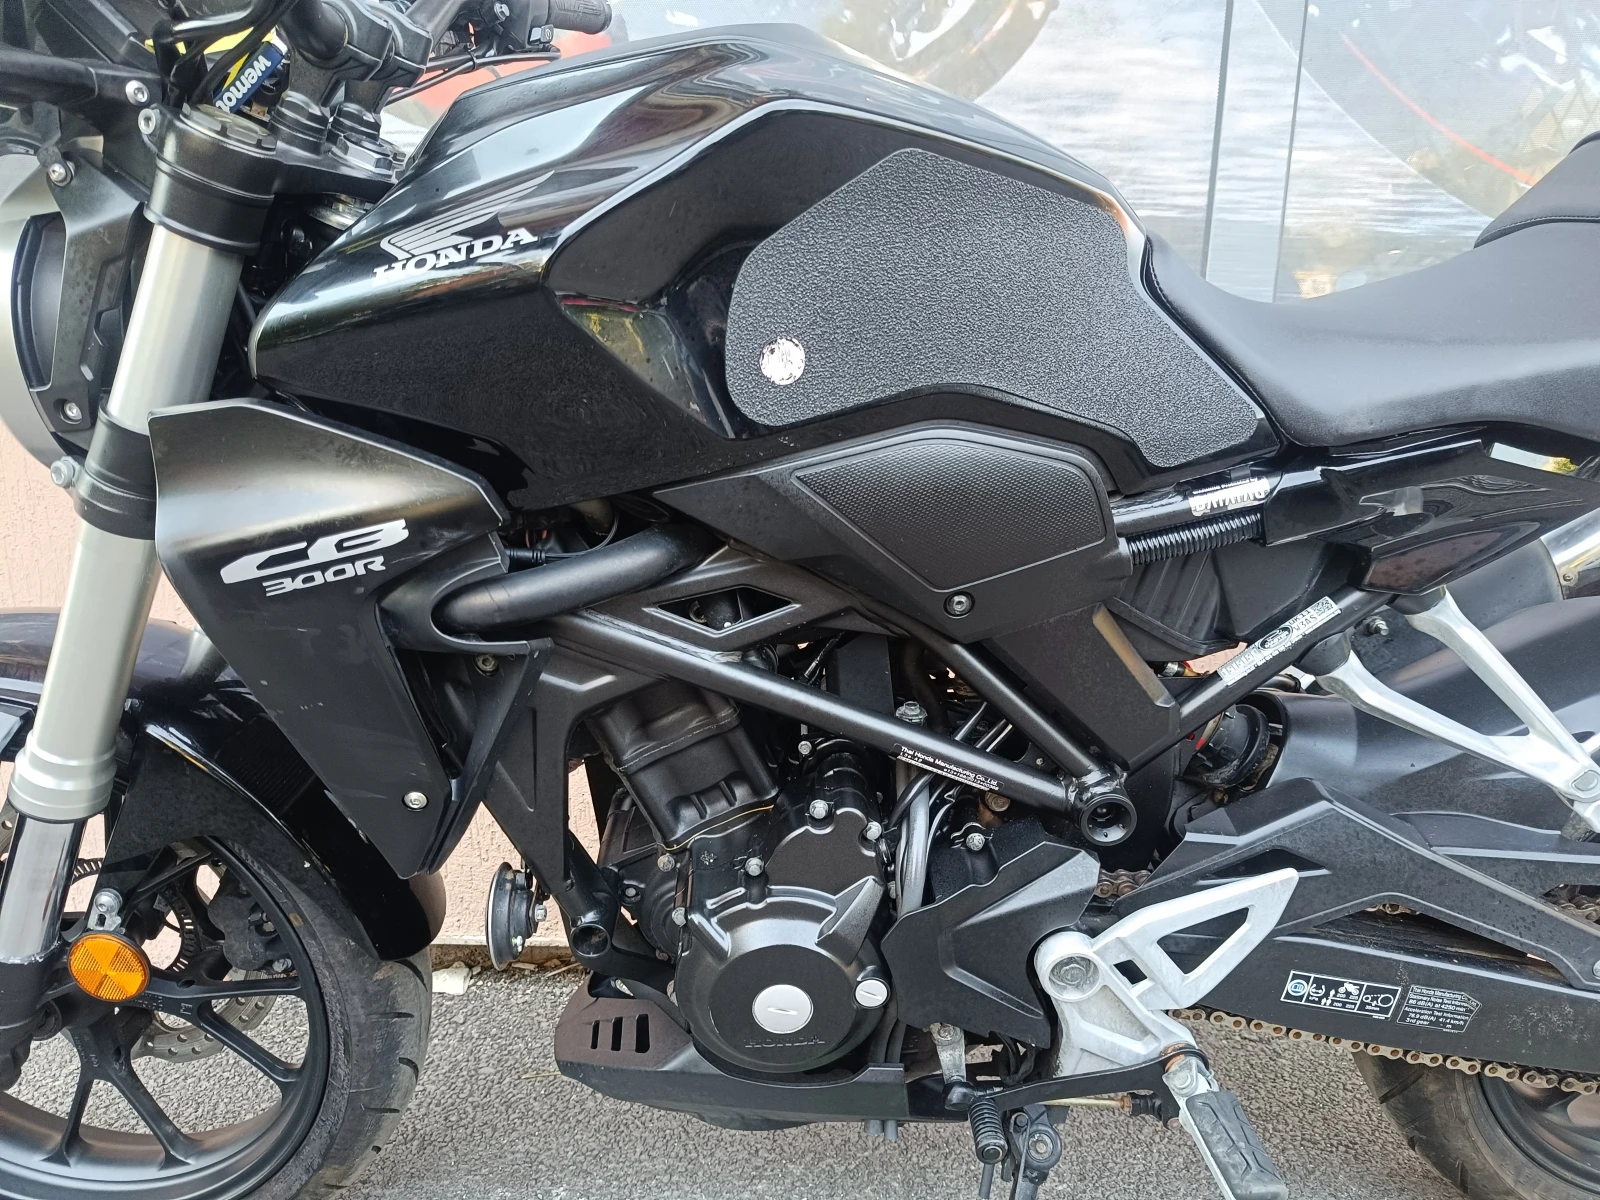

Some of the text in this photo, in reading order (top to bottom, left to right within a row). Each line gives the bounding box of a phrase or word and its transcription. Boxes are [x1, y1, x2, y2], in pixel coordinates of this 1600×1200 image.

[372, 227, 539, 287] HONDA
[220, 518, 410, 584] CB
[262, 555, 386, 597] 300R
[901, 746, 914, 755] Thai
[914, 752, 934, 763] Honda
[934, 759, 976, 778] Manufacturing
[1404, 1006, 1433, 1015] Acceleration
[743, 1036, 826, 1048] HONDA
